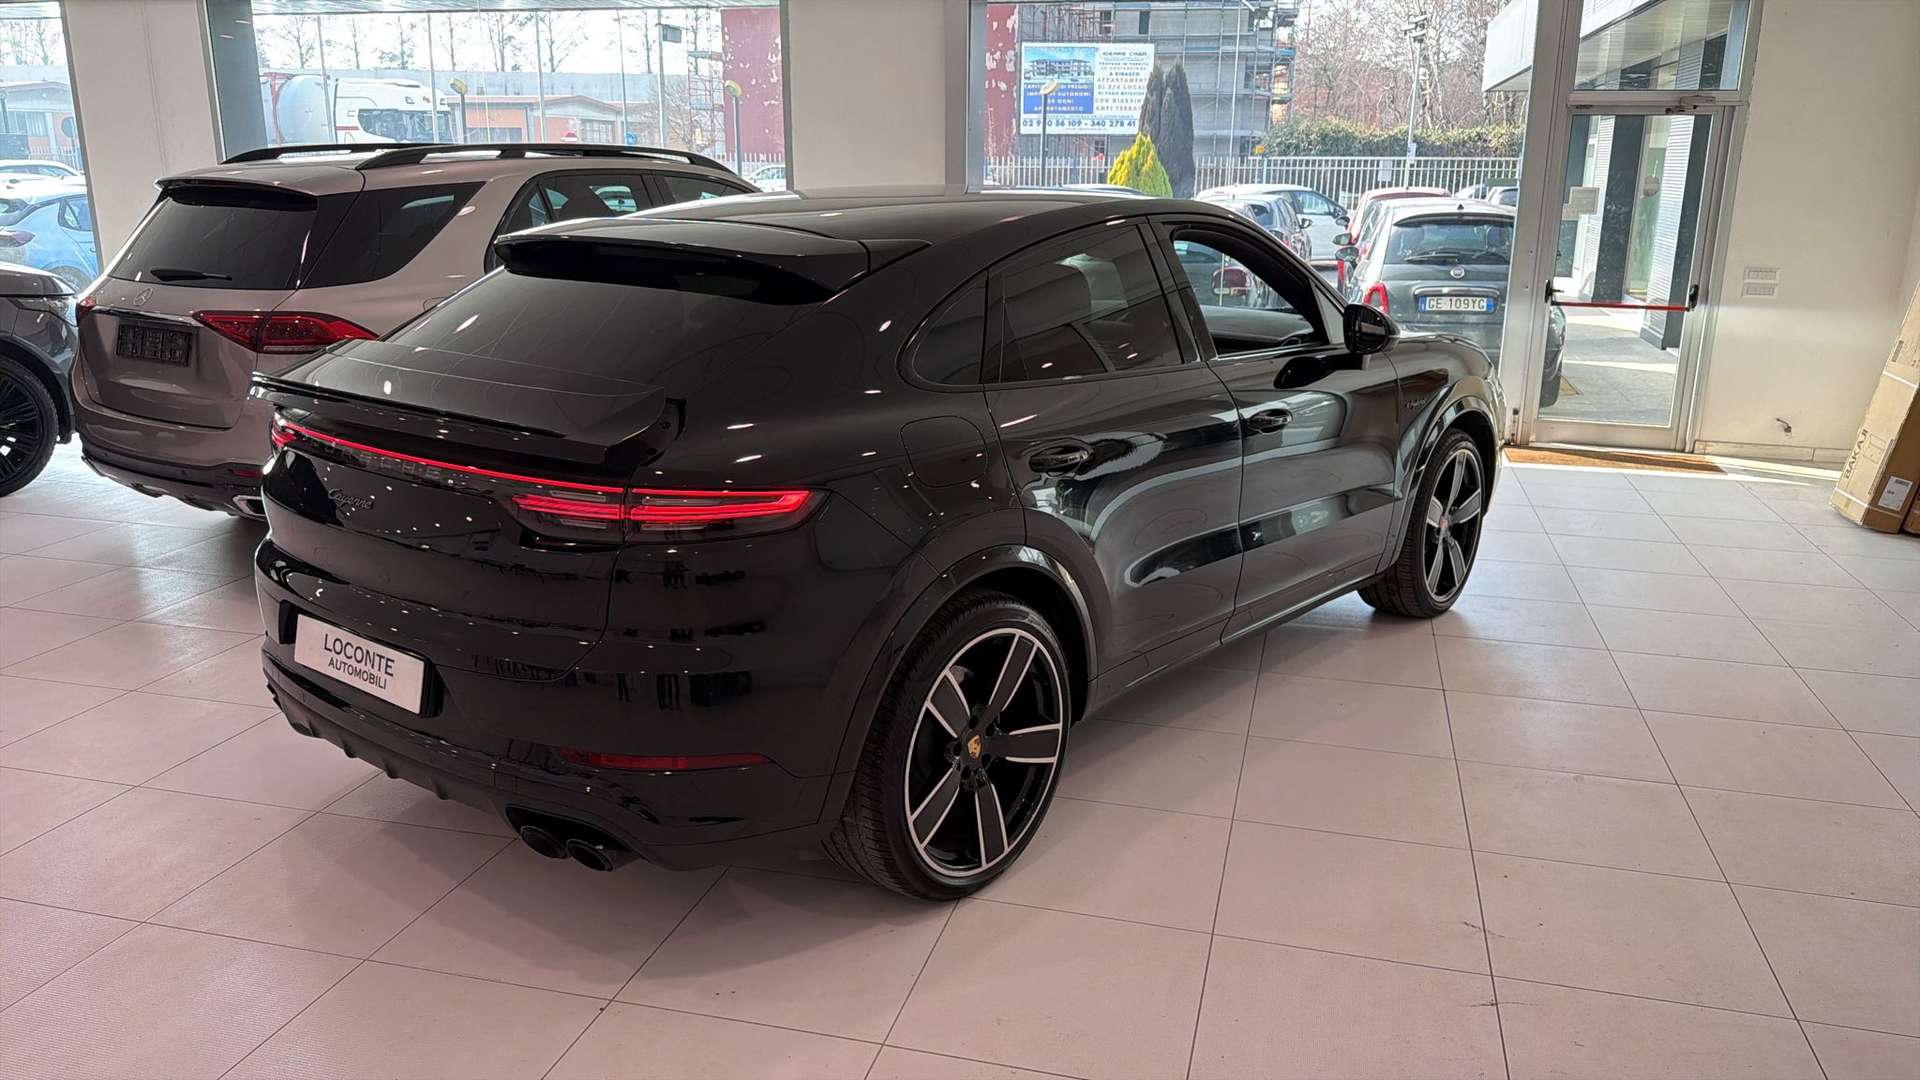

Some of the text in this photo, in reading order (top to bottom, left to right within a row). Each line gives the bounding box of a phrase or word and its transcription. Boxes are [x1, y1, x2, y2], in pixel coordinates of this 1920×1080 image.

[1845, 429, 1868, 479] BAKAJI
[328, 488, 374, 510] Cayenne
[323, 633, 395, 677] LOCONTE
[328, 657, 387, 690] AUTOMOBILI
